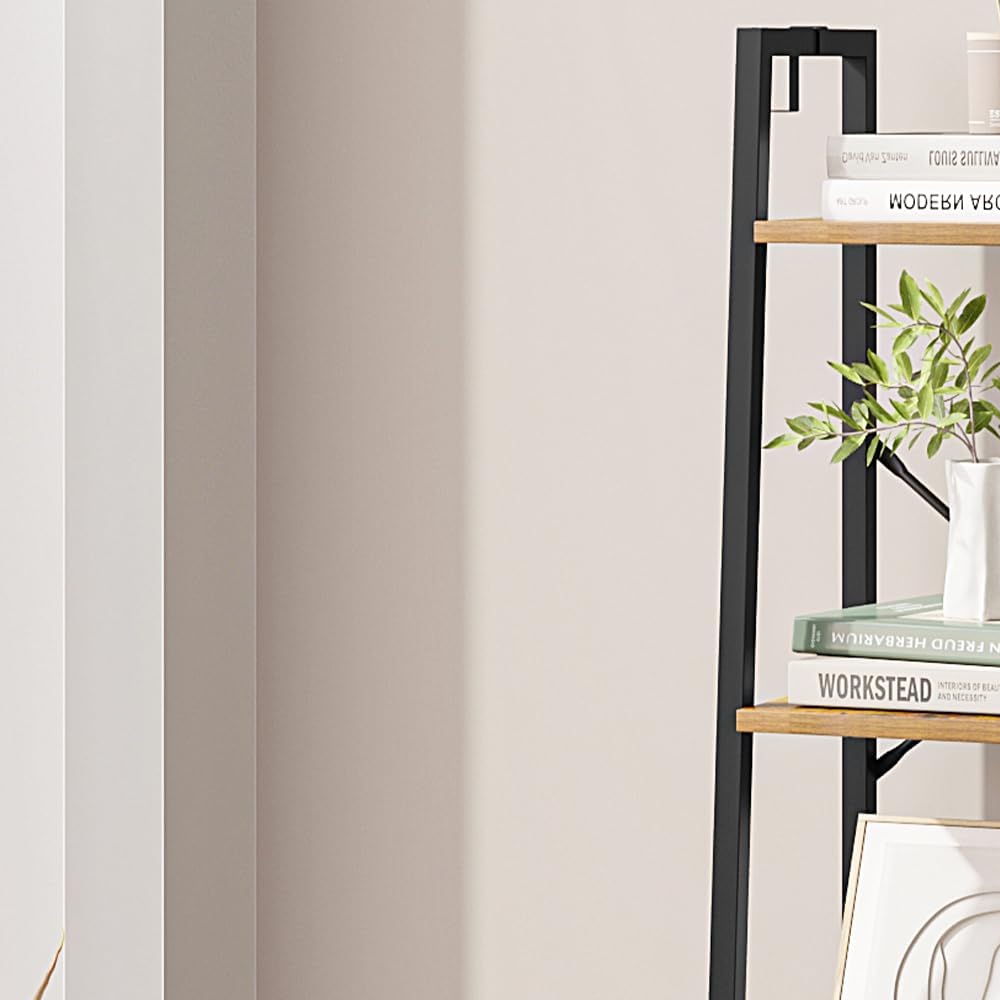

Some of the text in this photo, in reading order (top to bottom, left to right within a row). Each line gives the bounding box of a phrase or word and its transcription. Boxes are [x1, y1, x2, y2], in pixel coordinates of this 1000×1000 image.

[832, 632, 926, 649] HERBARIUM
[931, 638, 985, 653] FREUD
[818, 673, 932, 703] WORKSTEAD
[937, 681, 971, 692] INTERIORS
[972, 683, 980, 692] OF
[937, 692, 987, 703] AND NECESSITY
